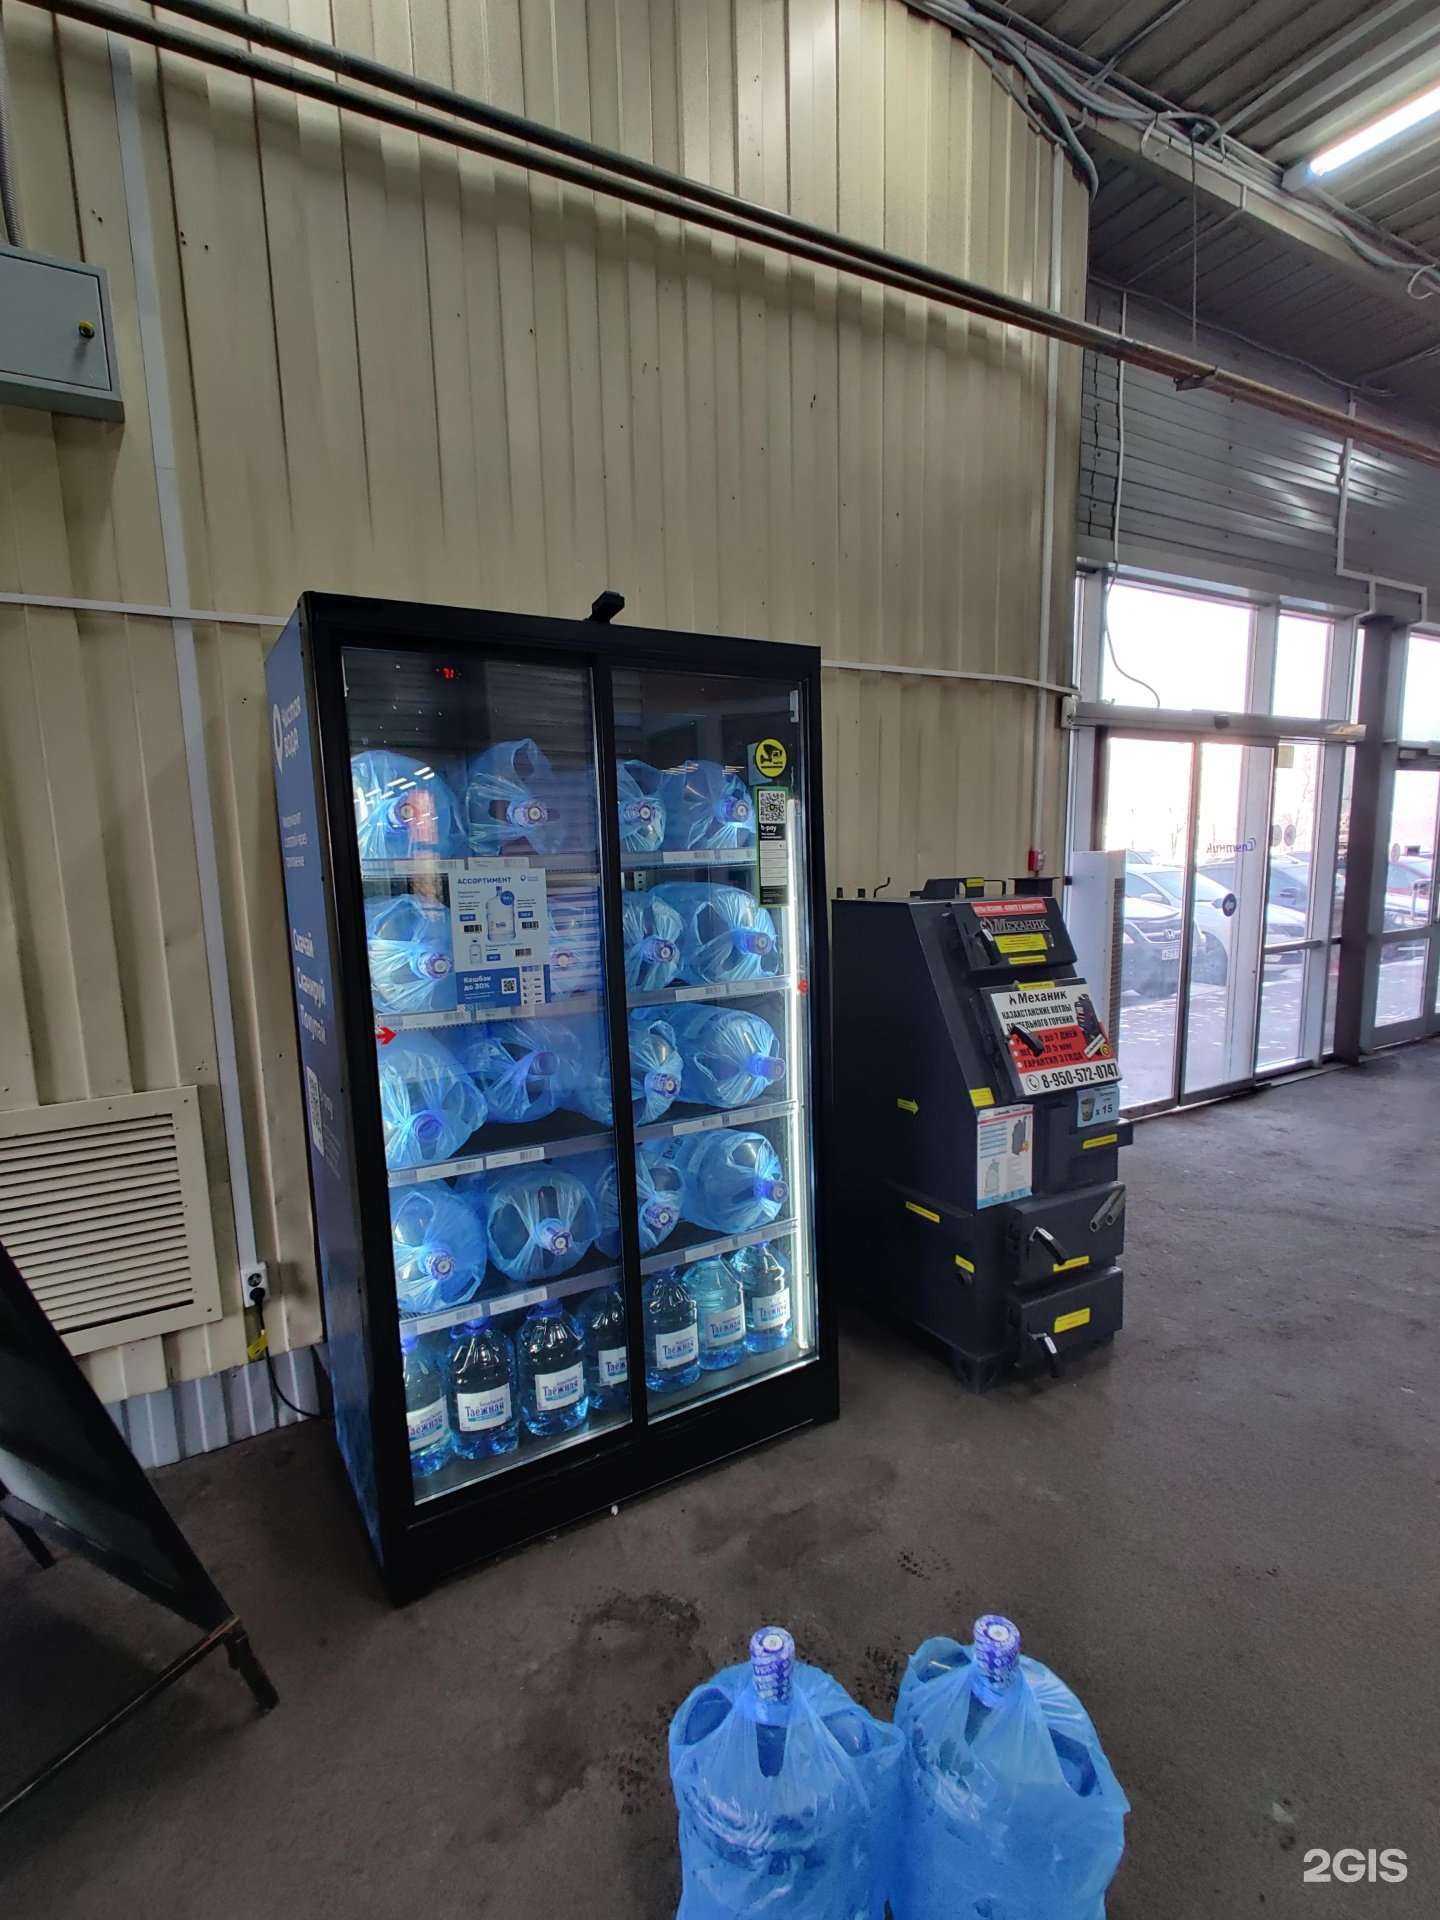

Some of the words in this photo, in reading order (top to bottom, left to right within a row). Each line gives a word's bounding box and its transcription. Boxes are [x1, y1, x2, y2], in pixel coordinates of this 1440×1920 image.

[457, 876, 512, 885] АССОРТИМЕНТ
[1018, 990, 1067, 1004] Механик
[1041, 1063, 1119, 1088] 8-950-572-0747
[1102, 1104, 1113, 1115] 15
